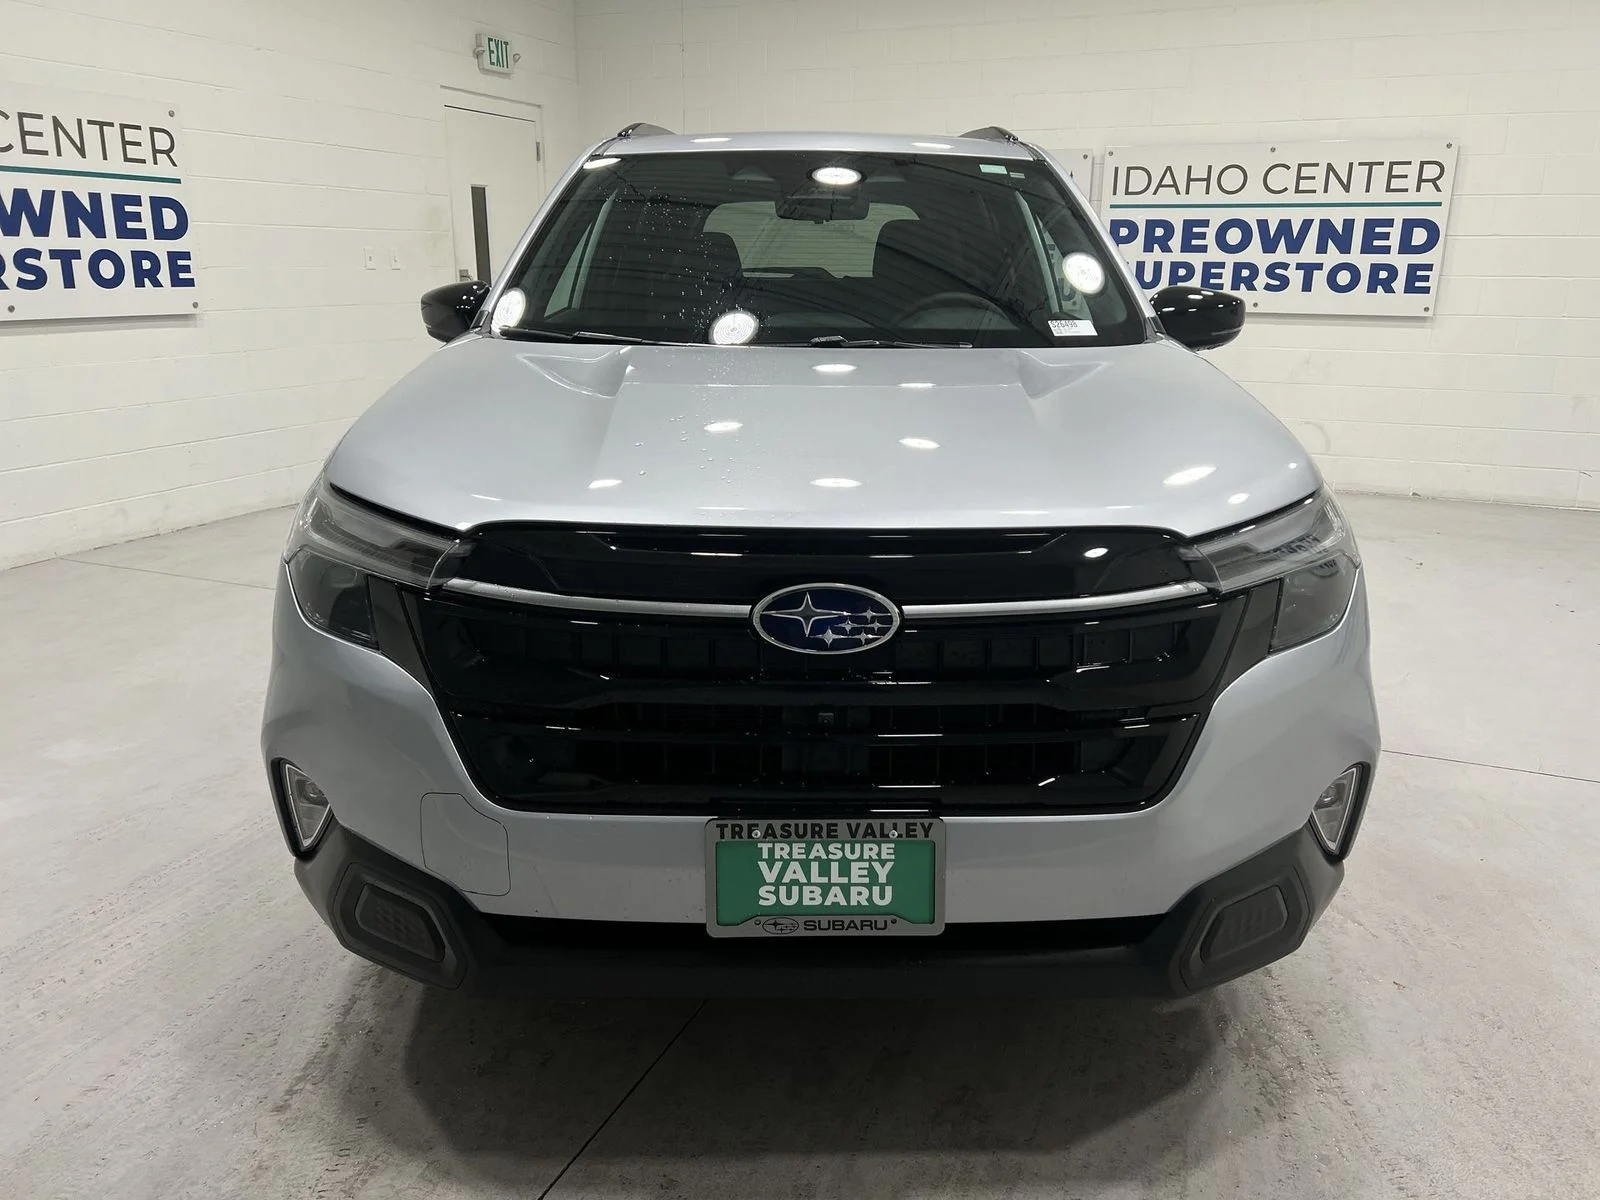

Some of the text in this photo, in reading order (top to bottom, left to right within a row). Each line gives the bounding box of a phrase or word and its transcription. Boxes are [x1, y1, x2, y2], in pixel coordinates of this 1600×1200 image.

[487, 37, 509, 69] EXIT
[1112, 160, 1446, 196] IDAHO CENTER
[1109, 217, 1441, 255] PREOWNED
[0, 247, 196, 291] STORE
[1134, 260, 1435, 295] UPERSTORE
[716, 823, 838, 840] TREASURE
[757, 842, 895, 860] TREASURE
[757, 861, 895, 884] VALLEY
[758, 885, 893, 906] SUBARU
[803, 919, 888, 931] SUBARU
